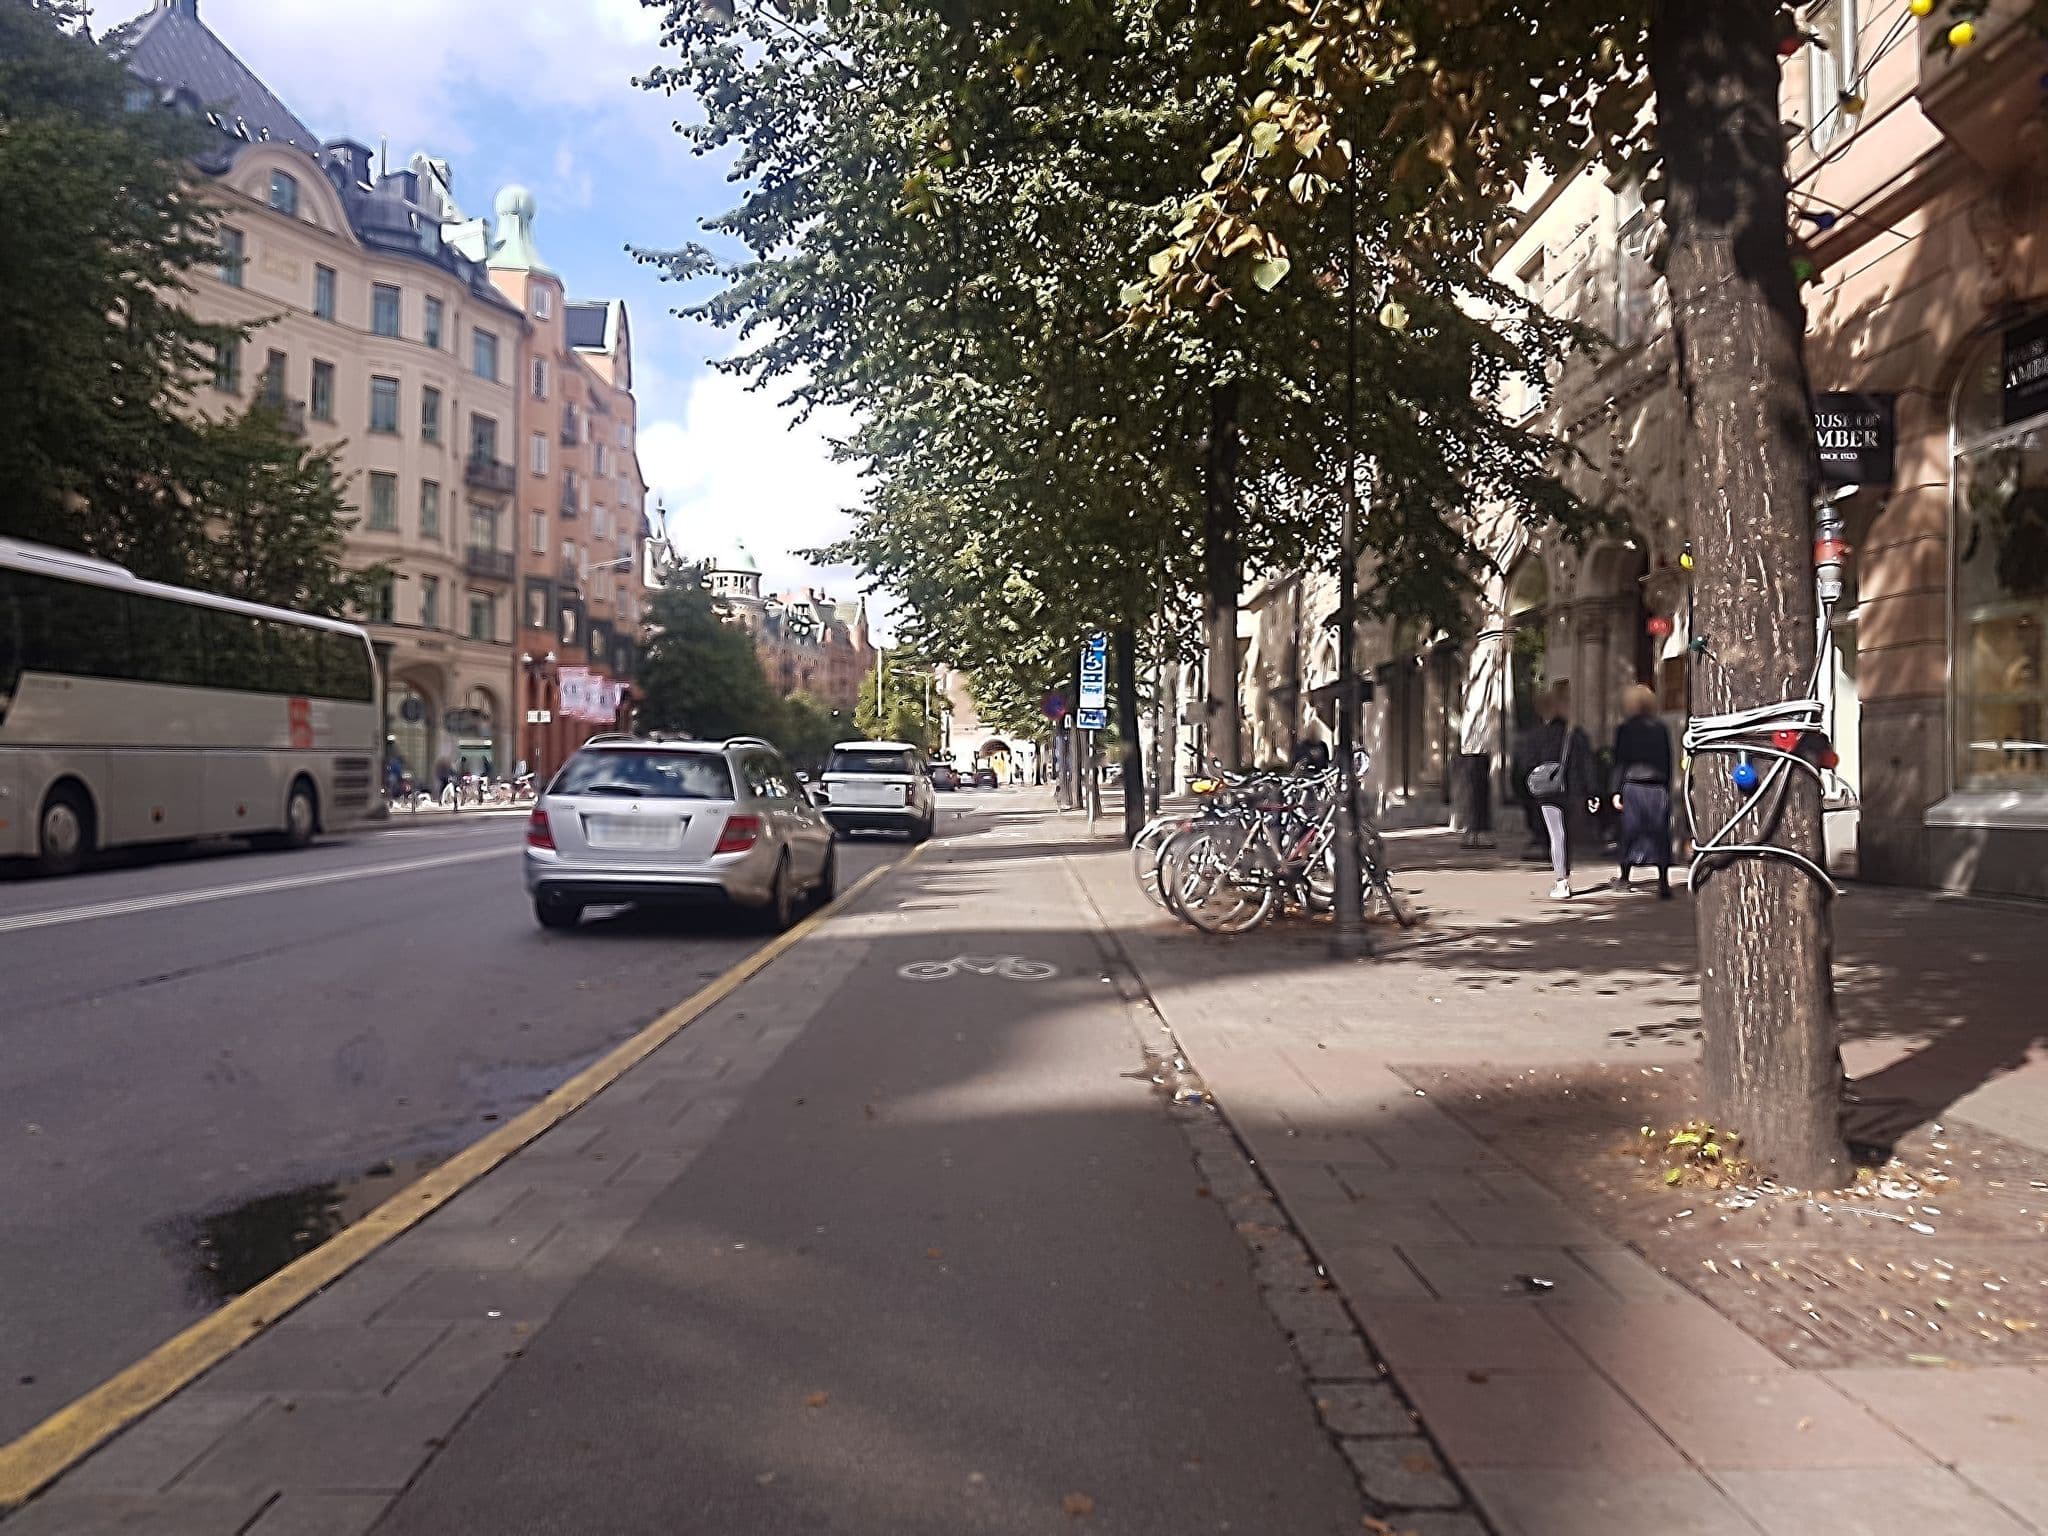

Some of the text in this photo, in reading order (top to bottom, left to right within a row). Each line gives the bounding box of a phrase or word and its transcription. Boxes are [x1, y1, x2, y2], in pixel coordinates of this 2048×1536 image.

[2005, 356, 2048, 389] AMBE
[1814, 414, 1849, 428] OUSE
[1815, 430, 1879, 448] MBER
